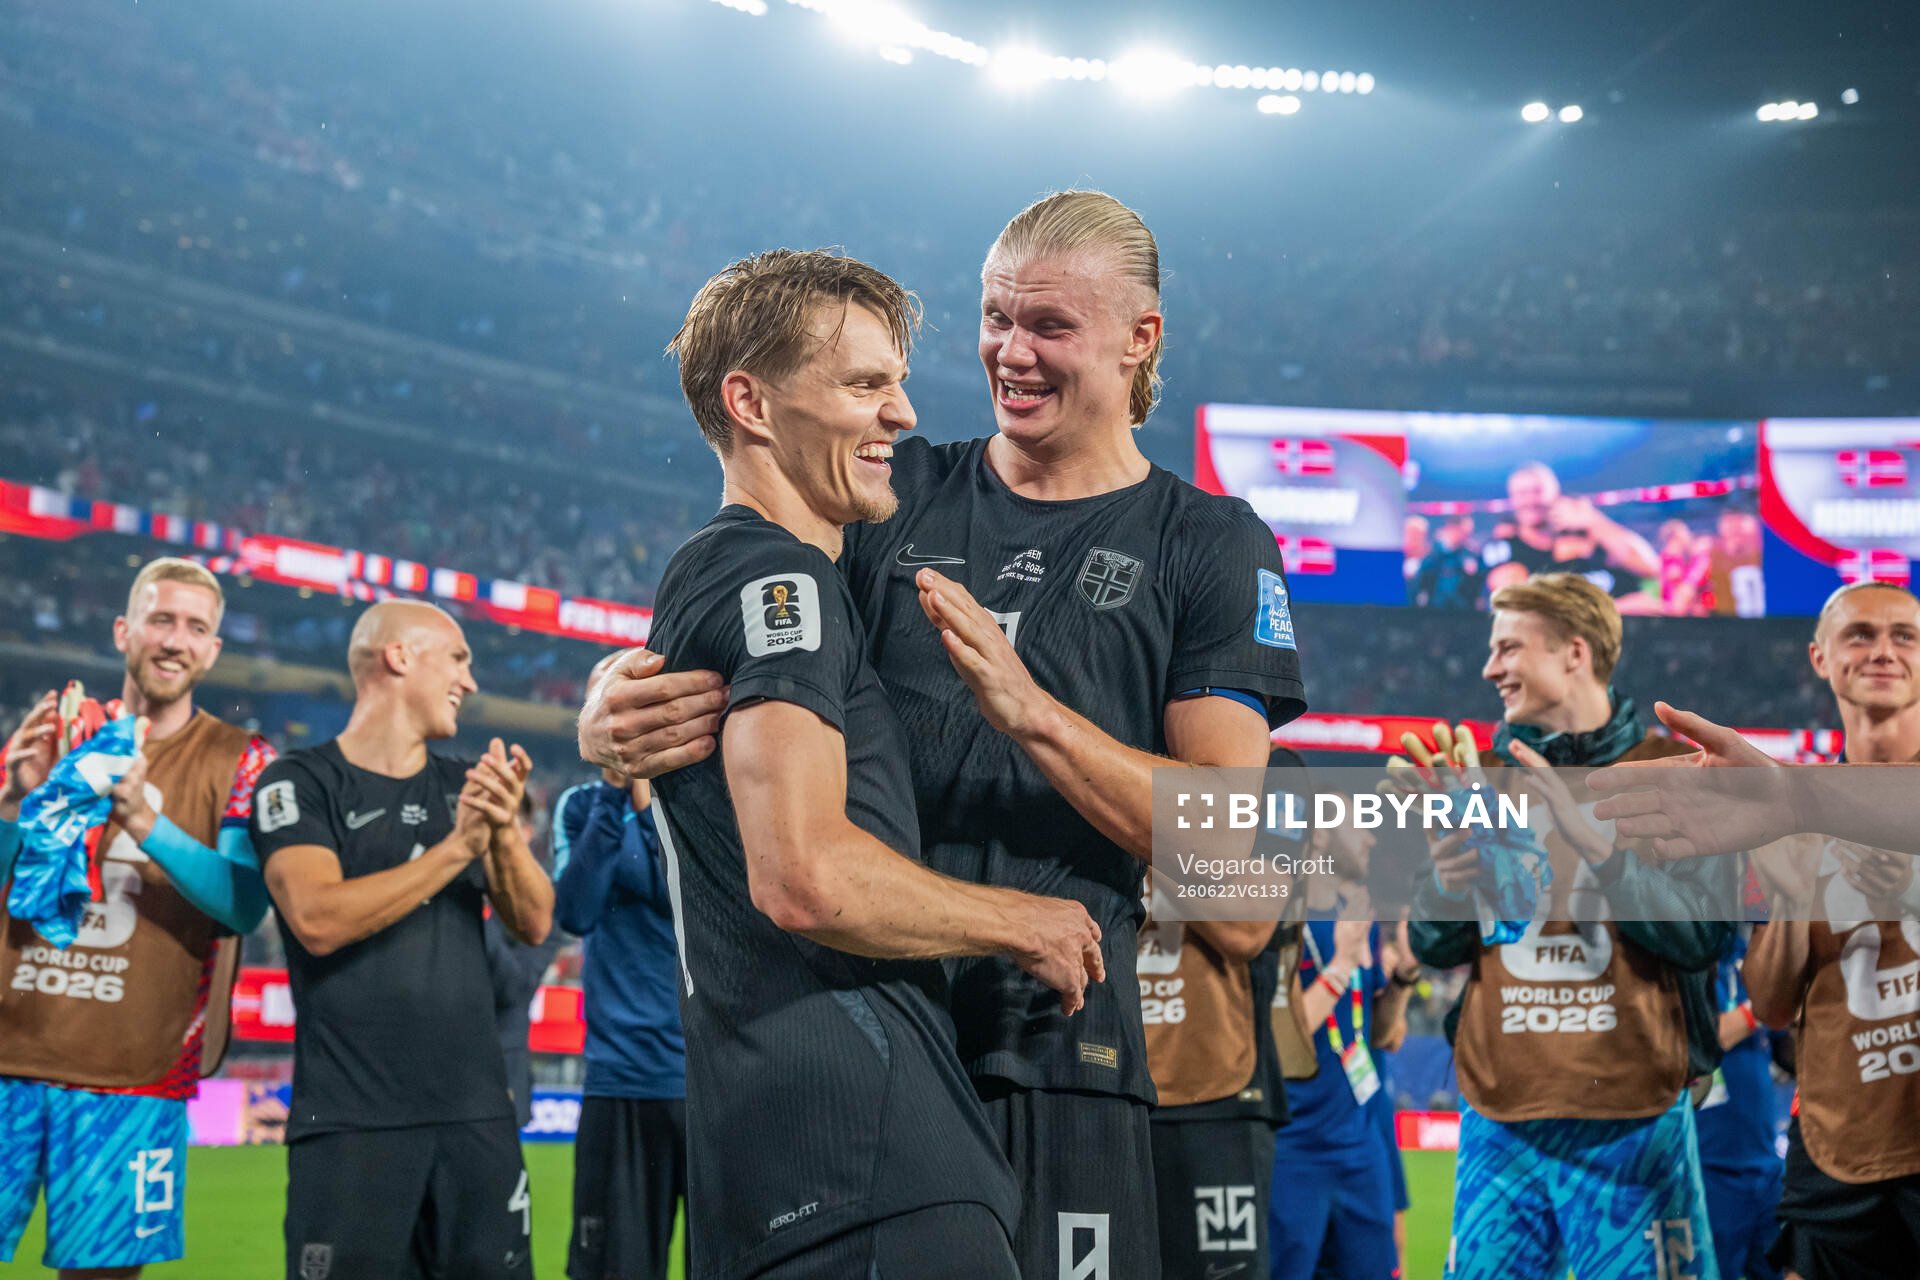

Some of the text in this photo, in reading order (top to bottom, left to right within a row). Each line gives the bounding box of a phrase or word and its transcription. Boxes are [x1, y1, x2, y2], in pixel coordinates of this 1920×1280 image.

[775, 618, 793, 626] FIFA
[1269, 618, 1294, 633] PEAC
[767, 635, 803, 647] 2026
[89, 954, 129, 974] CUP
[1536, 943, 1587, 963] FIFA
[10, 963, 125, 1003] 2026
[1500, 984, 1616, 1005] WORLD CUP
[1877, 970, 1920, 1001] FIF
[1140, 997, 1187, 1025] 26
[1501, 1004, 1618, 1034] 2026
[1852, 1019, 1920, 1051] WORL
[1858, 1043, 1920, 1084] 20
[128, 1147, 174, 1213] 13
[508, 1169, 530, 1236] 4
[769, 1201, 819, 1232] AERO-FIT
[1195, 1185, 1257, 1251] 25
